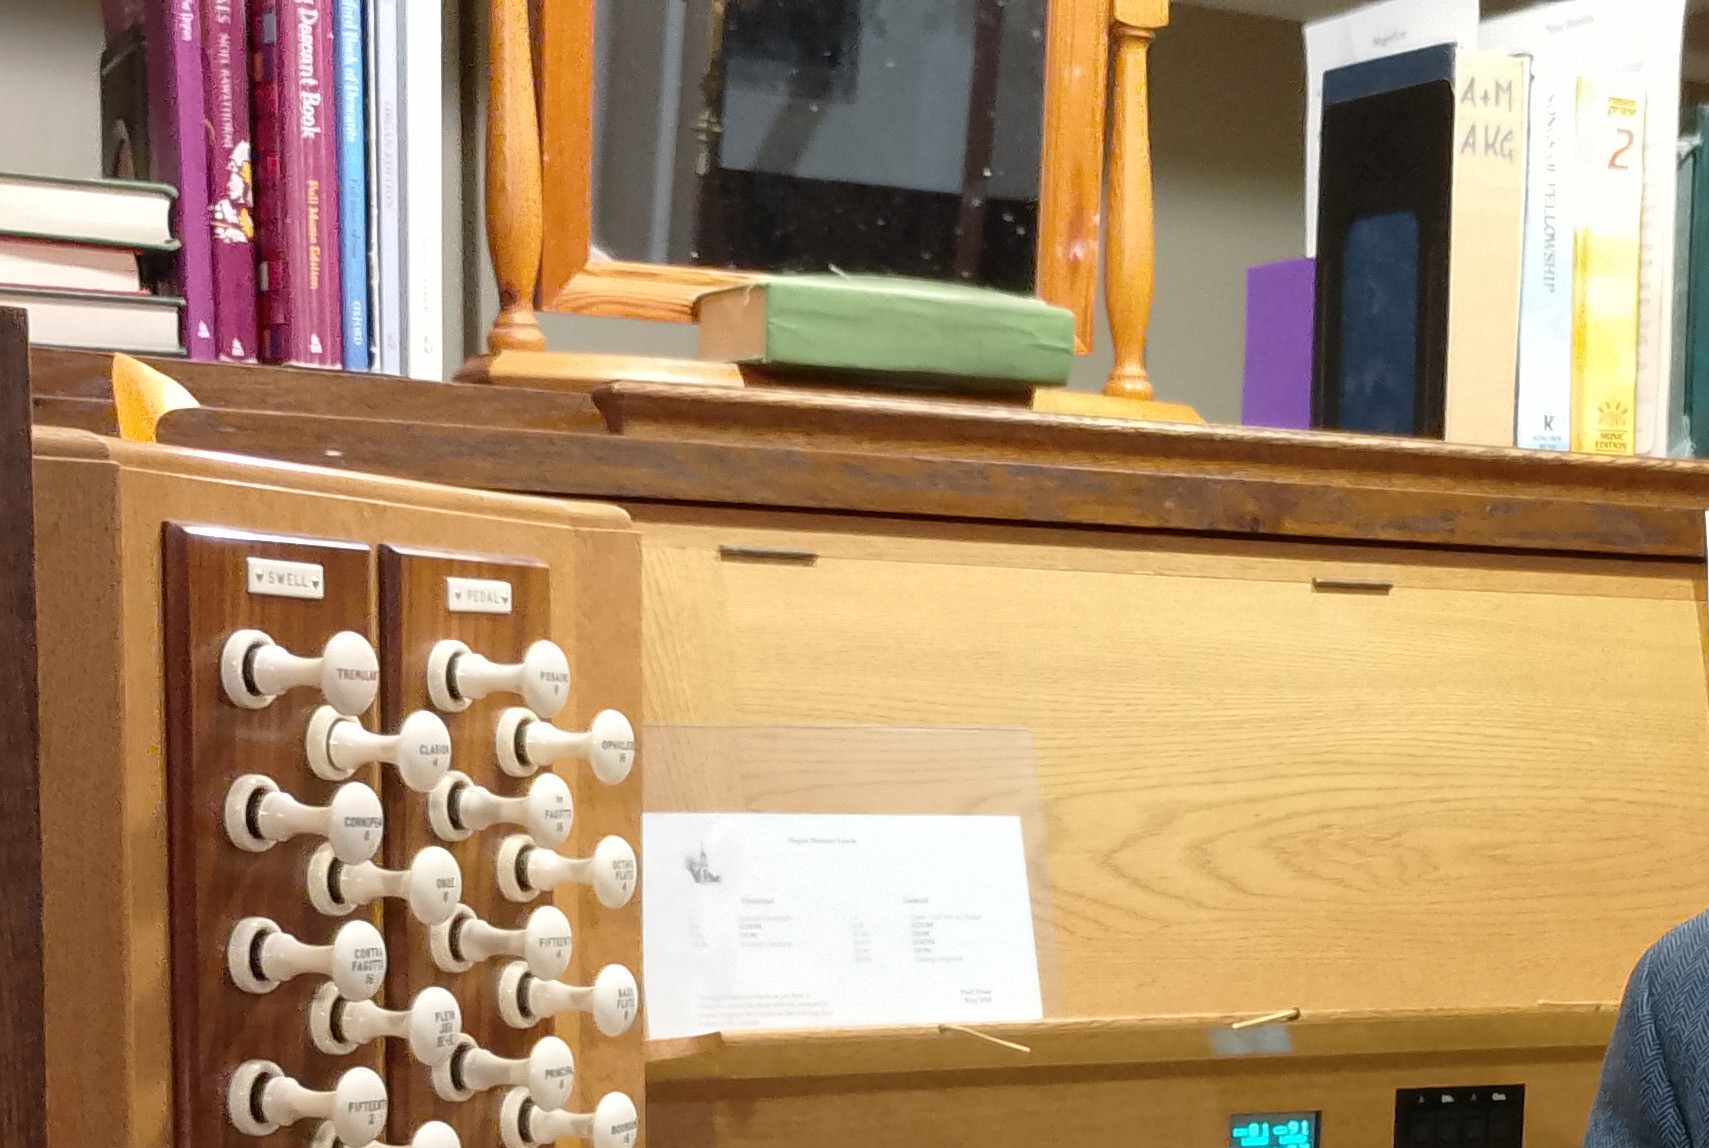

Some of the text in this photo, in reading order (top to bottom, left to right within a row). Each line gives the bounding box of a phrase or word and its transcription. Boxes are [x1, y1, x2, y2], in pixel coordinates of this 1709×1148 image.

[297, 8, 321, 139] Descant Book
[1461, 76, 1512, 112] A+M
[1608, 128, 1634, 171] 2
[1543, 182, 1556, 293] FELLOWSHIP
[1543, 414, 1555, 431] K
[1595, 441, 1627, 450] EDITION
[267, 572, 309, 588] SWELL
[467, 589, 500, 604] PEDAL
